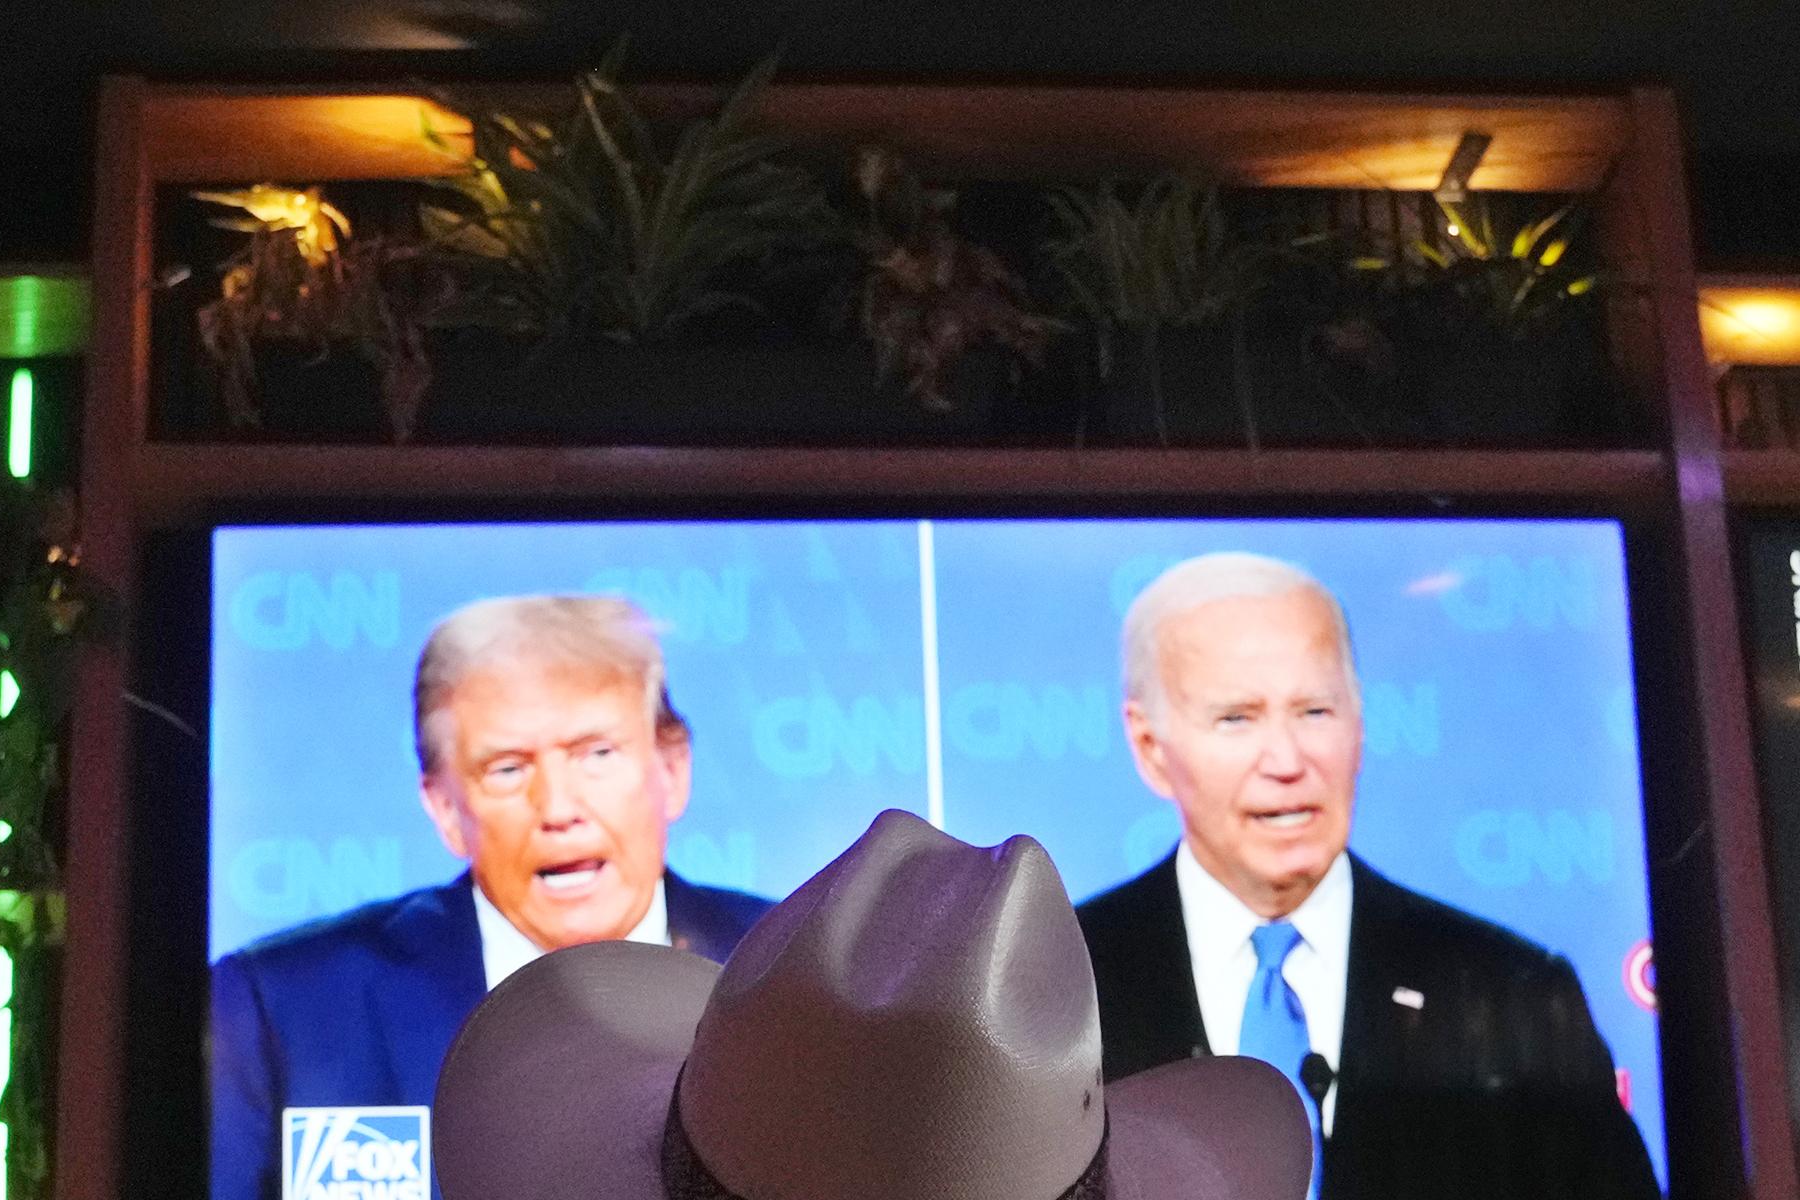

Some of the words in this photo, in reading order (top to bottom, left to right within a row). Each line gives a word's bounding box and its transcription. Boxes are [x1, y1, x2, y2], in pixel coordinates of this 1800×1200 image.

[230, 570, 400, 650] CNN
[1440, 556, 1594, 630] CNN
[751, 697, 924, 777] CNN
[946, 682, 1108, 760] CNN
[228, 837, 402, 918] CNN
[1457, 811, 1614, 887] CNN
[332, 1140, 418, 1181] FOX
